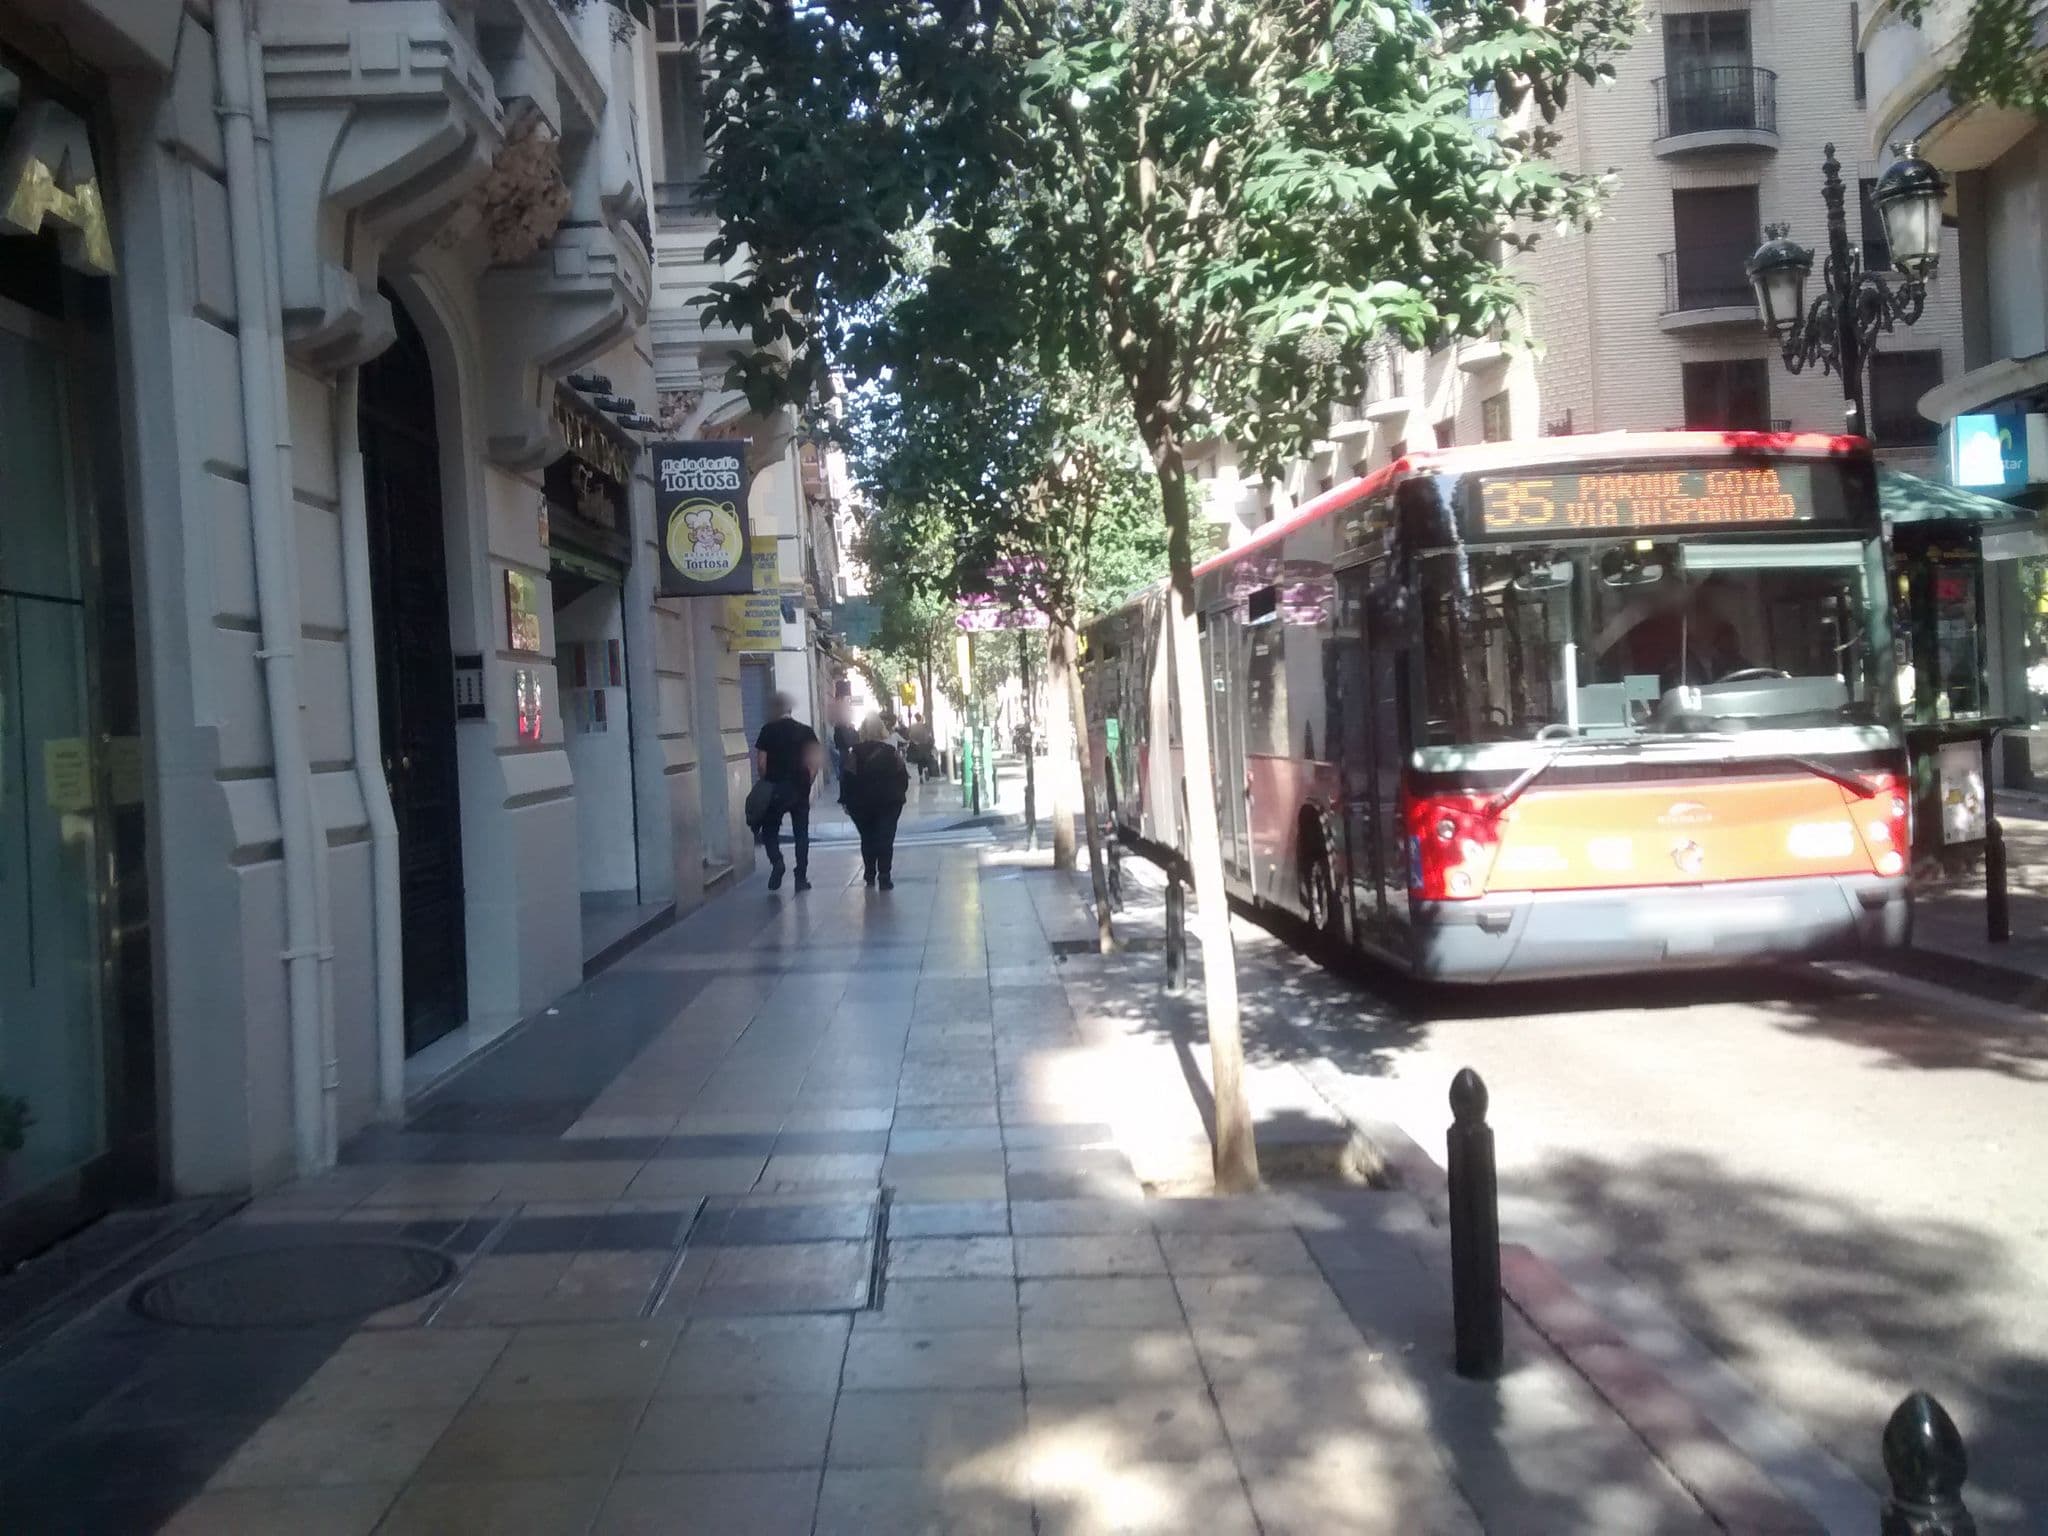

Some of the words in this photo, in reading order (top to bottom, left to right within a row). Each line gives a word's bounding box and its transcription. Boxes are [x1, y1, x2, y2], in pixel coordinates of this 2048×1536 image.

[663, 472, 739, 490] Tortosa
[1579, 472, 1689, 500] PARQUE
[1706, 468, 1780, 495] GOYA
[1485, 480, 1555, 526] 35
[1566, 501, 1618, 528] VIA
[1632, 494, 1796, 527] HISPANIDAD
[684, 559, 729, 570] Tortosa
